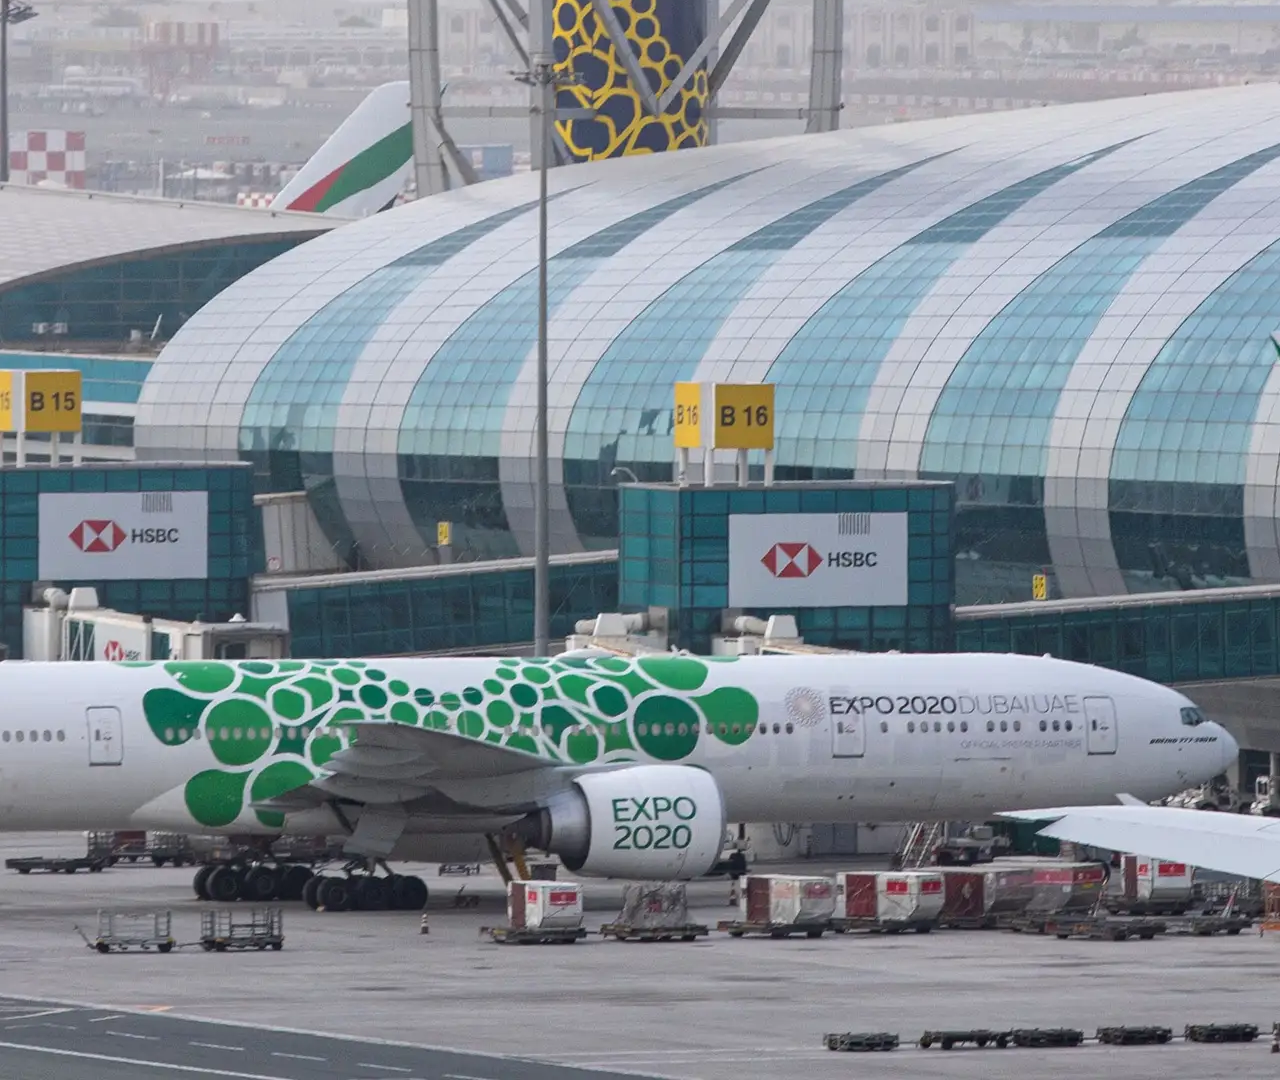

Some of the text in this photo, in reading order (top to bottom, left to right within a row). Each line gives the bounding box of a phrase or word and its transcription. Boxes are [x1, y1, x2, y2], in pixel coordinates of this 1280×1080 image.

[30, 391, 75, 411] B 15
[677, 404, 698, 426] B 16
[720, 405, 769, 427] B 16
[131, 527, 179, 544] HSBC
[828, 551, 878, 568] HSBC
[829, 695, 1079, 715] EXPO 2020 DUBAI UAE
[612, 796, 697, 822] EXPO
[613, 824, 692, 850] 2020
